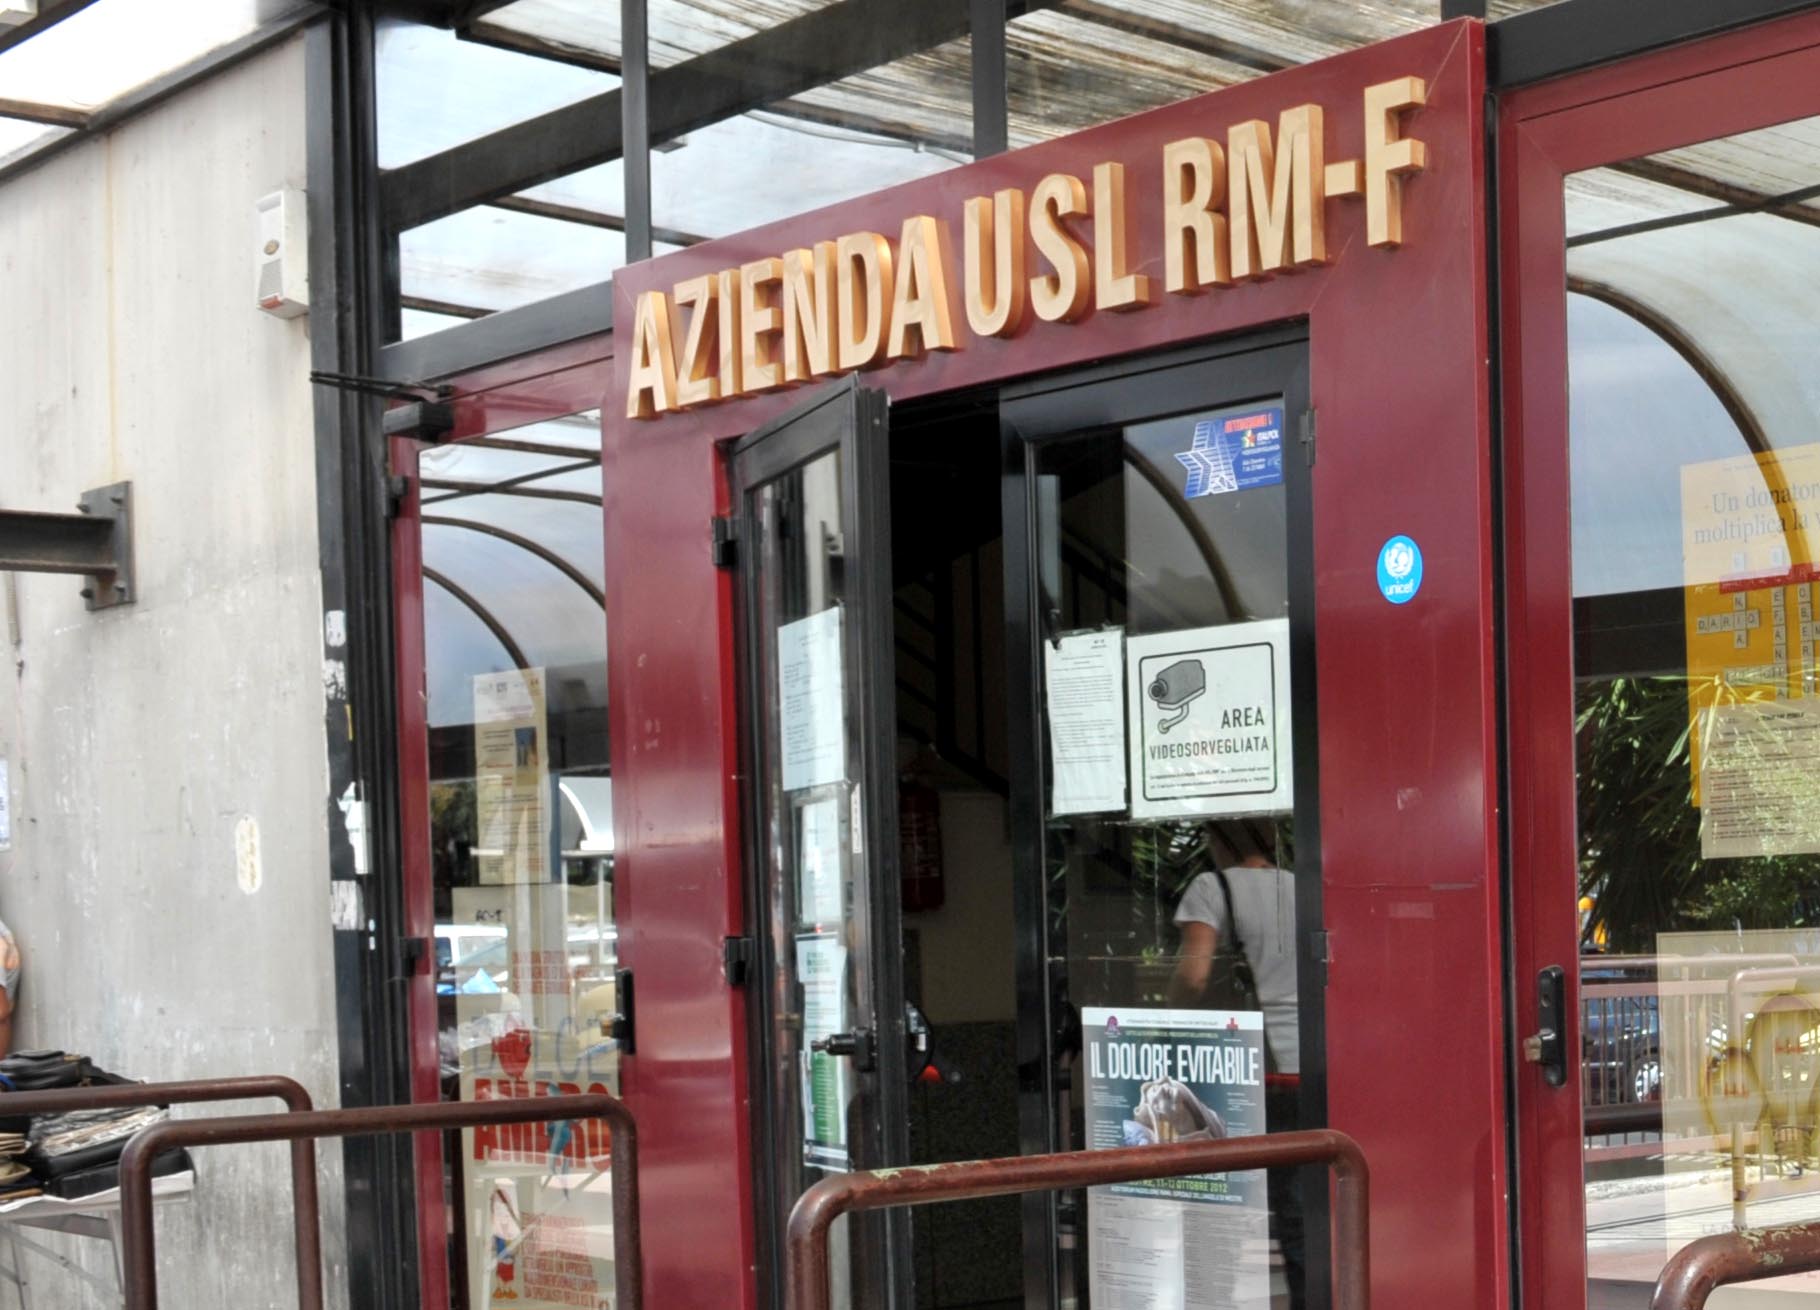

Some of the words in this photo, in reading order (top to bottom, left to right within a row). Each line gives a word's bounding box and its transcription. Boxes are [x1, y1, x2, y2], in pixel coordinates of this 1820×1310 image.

[625, 216, 958, 420] AZIENDA
[963, 161, 1151, 339] USL
[1162, 76, 1427, 295] RM-F
[1713, 492, 1739, 514] Un
[1694, 513, 1787, 543] moltiplica
[1221, 707, 1265, 729] AREA
[1150, 736, 1269, 760] VIDEOSORVEGLIATA
[1090, 1041, 1105, 1078] IL
[1108, 1042, 1172, 1081] DOLORE
[1177, 1045, 1260, 1086] EVITABILE
[1176, 1180, 1208, 1191] OTTOBRE
[1210, 1183, 1228, 1193] 2012
